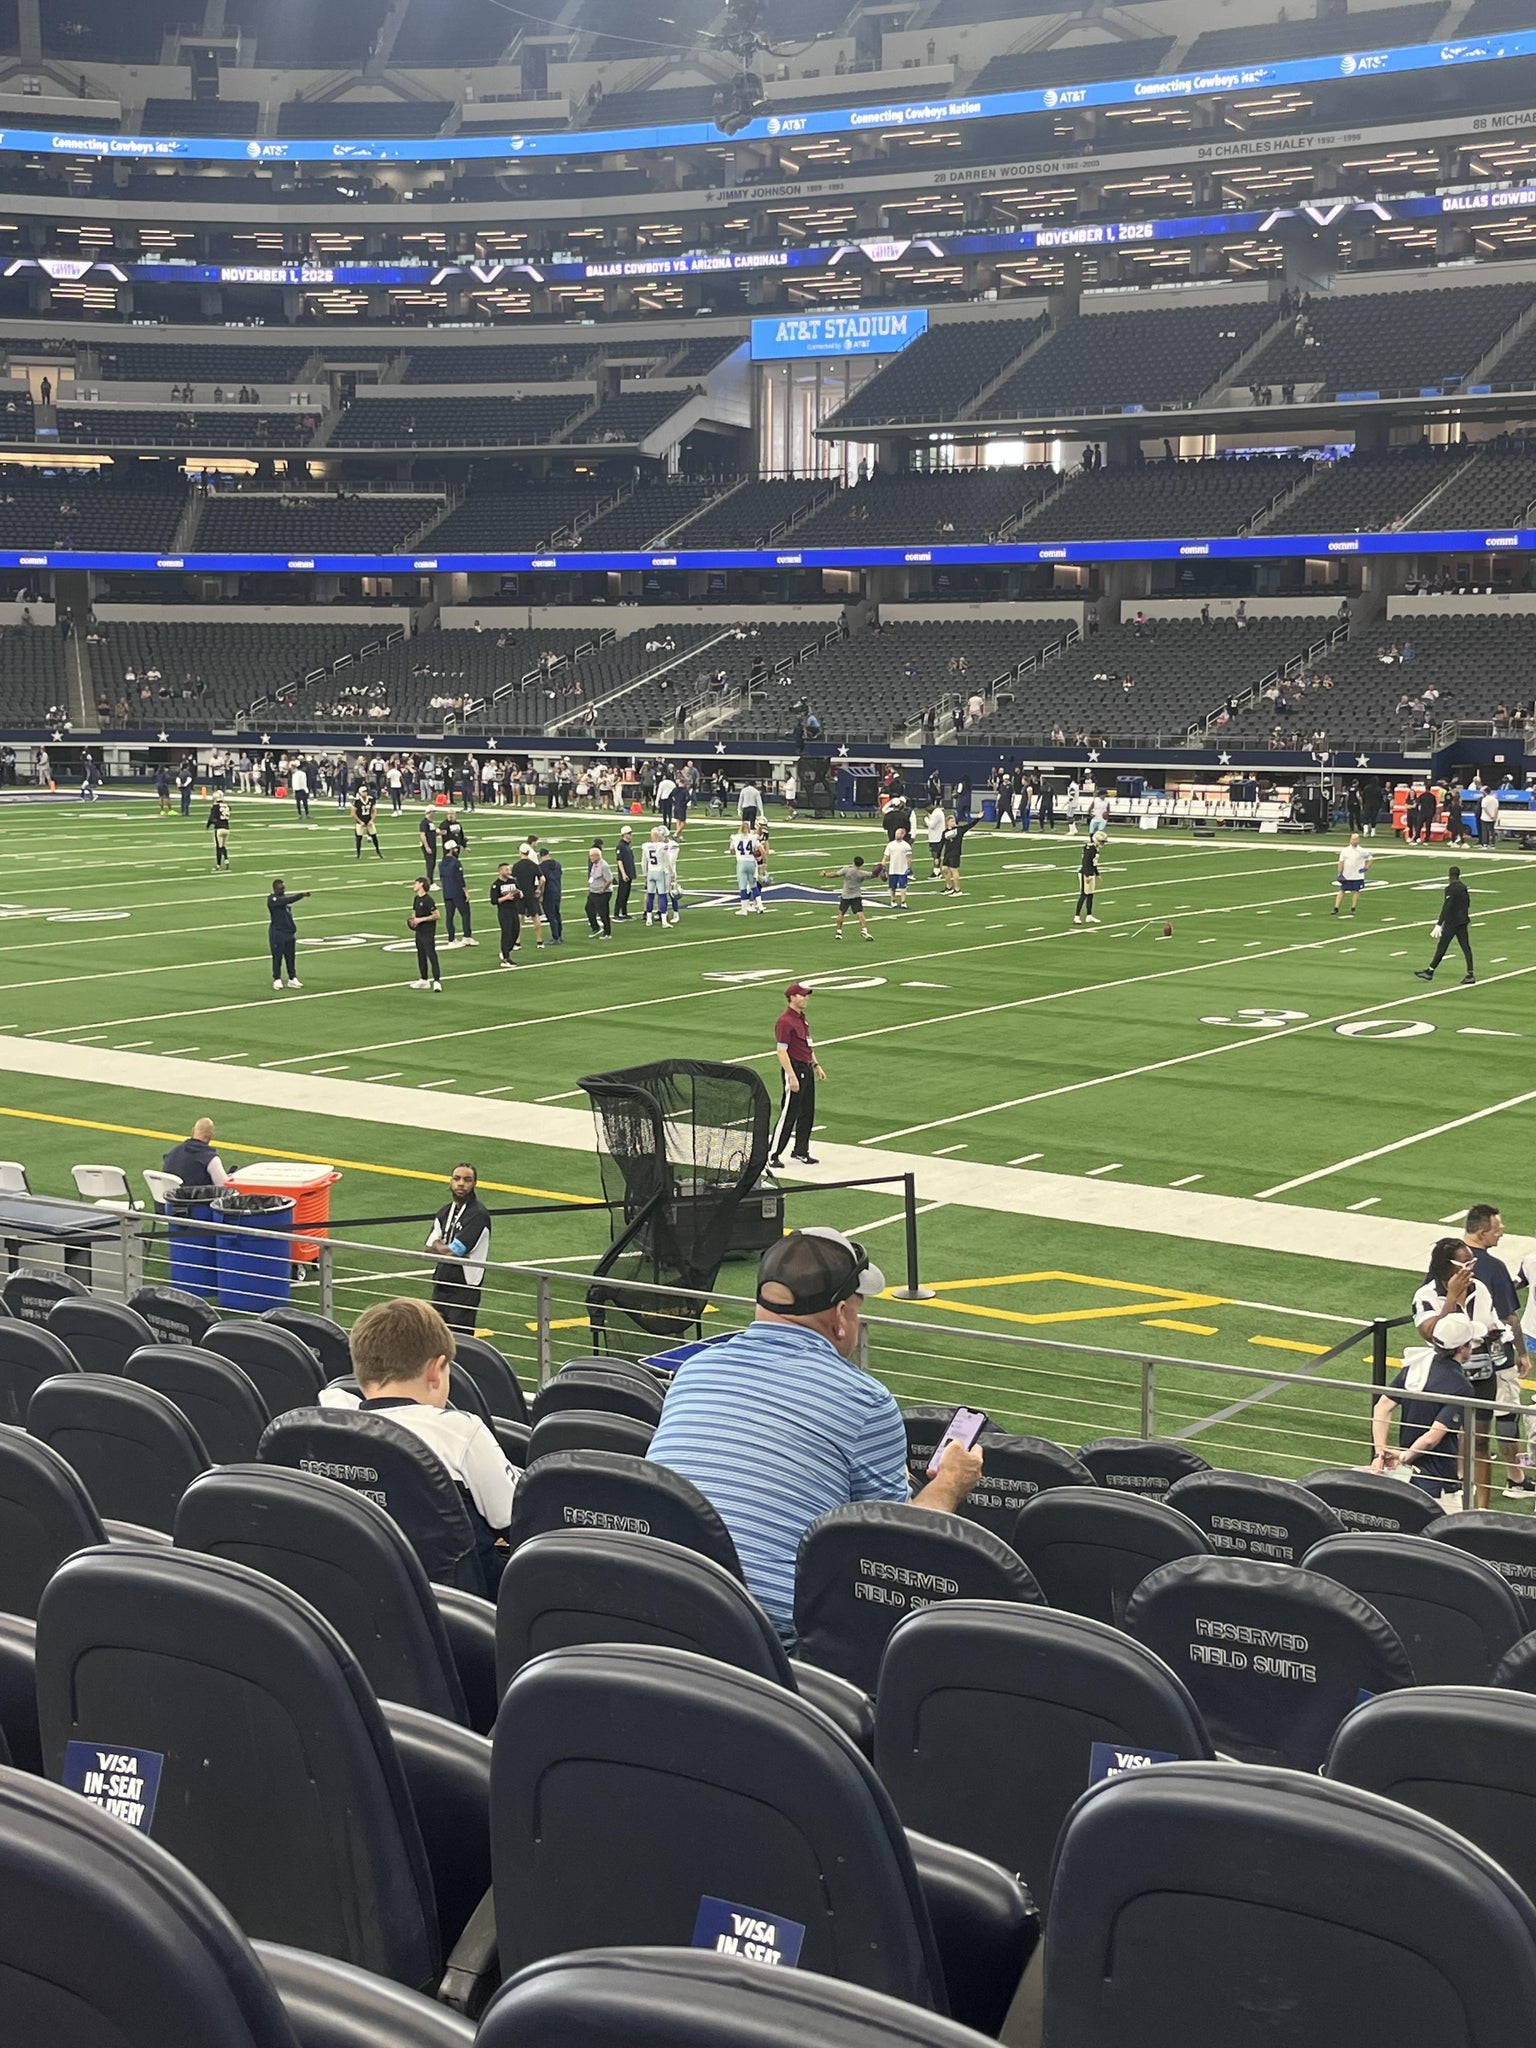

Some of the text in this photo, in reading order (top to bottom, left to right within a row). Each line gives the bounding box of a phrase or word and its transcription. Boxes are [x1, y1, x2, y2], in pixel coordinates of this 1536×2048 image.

[1059, 90, 1086, 103] AT&T
[1134, 79, 1192, 96] Connecting
[1194, 74, 1239, 90] Cowboys
[781, 118, 807, 131] AT&T
[850, 101, 981, 125] Connecting Cowboys Nation
[1473, 112, 1536, 129] 88 MICHAE
[52, 136, 109, 153] Connecting
[110, 140, 153, 154] Cowboys
[1197, 148, 1212, 158] 94
[1215, 141, 1271, 156] CHARLES
[1273, 137, 1314, 149] HALEY
[934, 173, 946, 183] 28
[950, 168, 996, 181] DARREN
[1000, 163, 1059, 176] WOODSON
[716, 189, 749, 201] JIMMY
[750, 185, 801, 198] JOHNSON
[1442, 190, 1536, 211] DALLAS COWBO
[1036, 223, 1153, 246] NOVEMBER 1, 2026
[221, 268, 334, 283] NOVEMBER 1, 2026
[586, 253, 788, 277] DALLAS COWBOYS VS. ARIZONA CARDINALS
[776, 315, 907, 341] AT&T STADIUM
[649, 850, 658, 865] 5
[737, 841, 753, 855] 44
[300, 1459, 379, 1482] RESERVED
[976, 1476, 1039, 1494] ESERVED
[563, 1506, 651, 1535] RESERVED
[1211, 1515, 1289, 1540] RESERVED
[1207, 1533, 1294, 1560] FIELD SUITE
[860, 1558, 959, 1595] RESERVED
[855, 1581, 906, 1608] FIELD
[1195, 1618, 1309, 1653] RESERVED
[1189, 1643, 1317, 1683] FIELD SUITE
[95, 1752, 139, 1775] VISA
[1114, 1752, 1152, 1769] VISA
[83, 1771, 144, 1801] IN-SEAT
[730, 1912, 777, 1947] VISA
[716, 1934, 782, 1966] IN-SEAT
